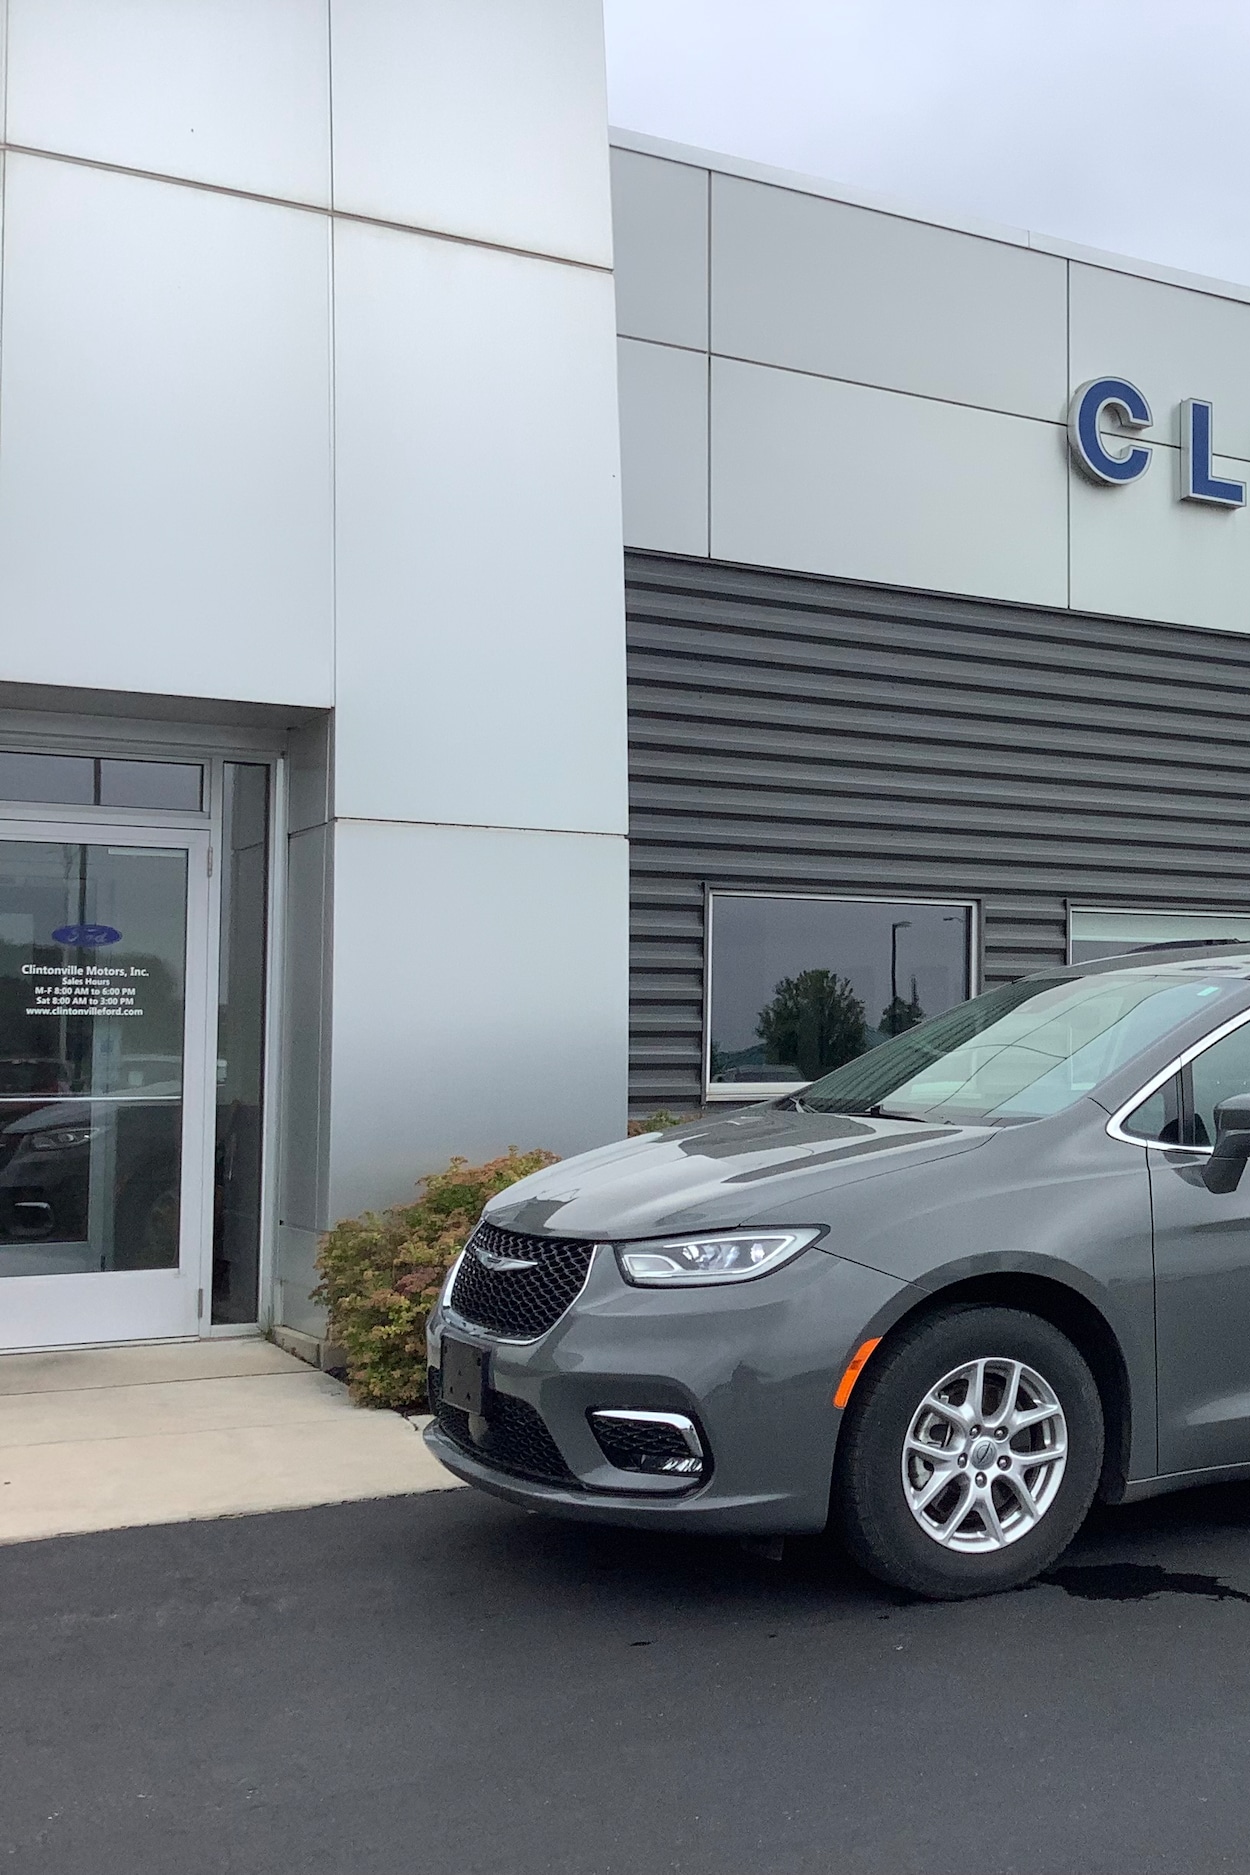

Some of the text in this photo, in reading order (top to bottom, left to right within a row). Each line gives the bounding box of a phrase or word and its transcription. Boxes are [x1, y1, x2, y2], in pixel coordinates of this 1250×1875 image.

[21, 964, 149, 977] Clintonville Motors, Inc.
[61, 977, 110, 986] Sales Hours
[35, 986, 53, 994] M-F
[54, 987, 73, 995] 8:00
[74, 987, 89, 995] AM
[102, 987, 120, 995] 6:00
[121, 988, 136, 996] PM
[36, 996, 51, 1004] Sat
[52, 997, 71, 1005] 8:00
[72, 997, 87, 1005] AM
[100, 997, 119, 1006] 3:00
[120, 998, 134, 1006] PM
[26, 1006, 144, 1016] www.clintonvilleford.com
